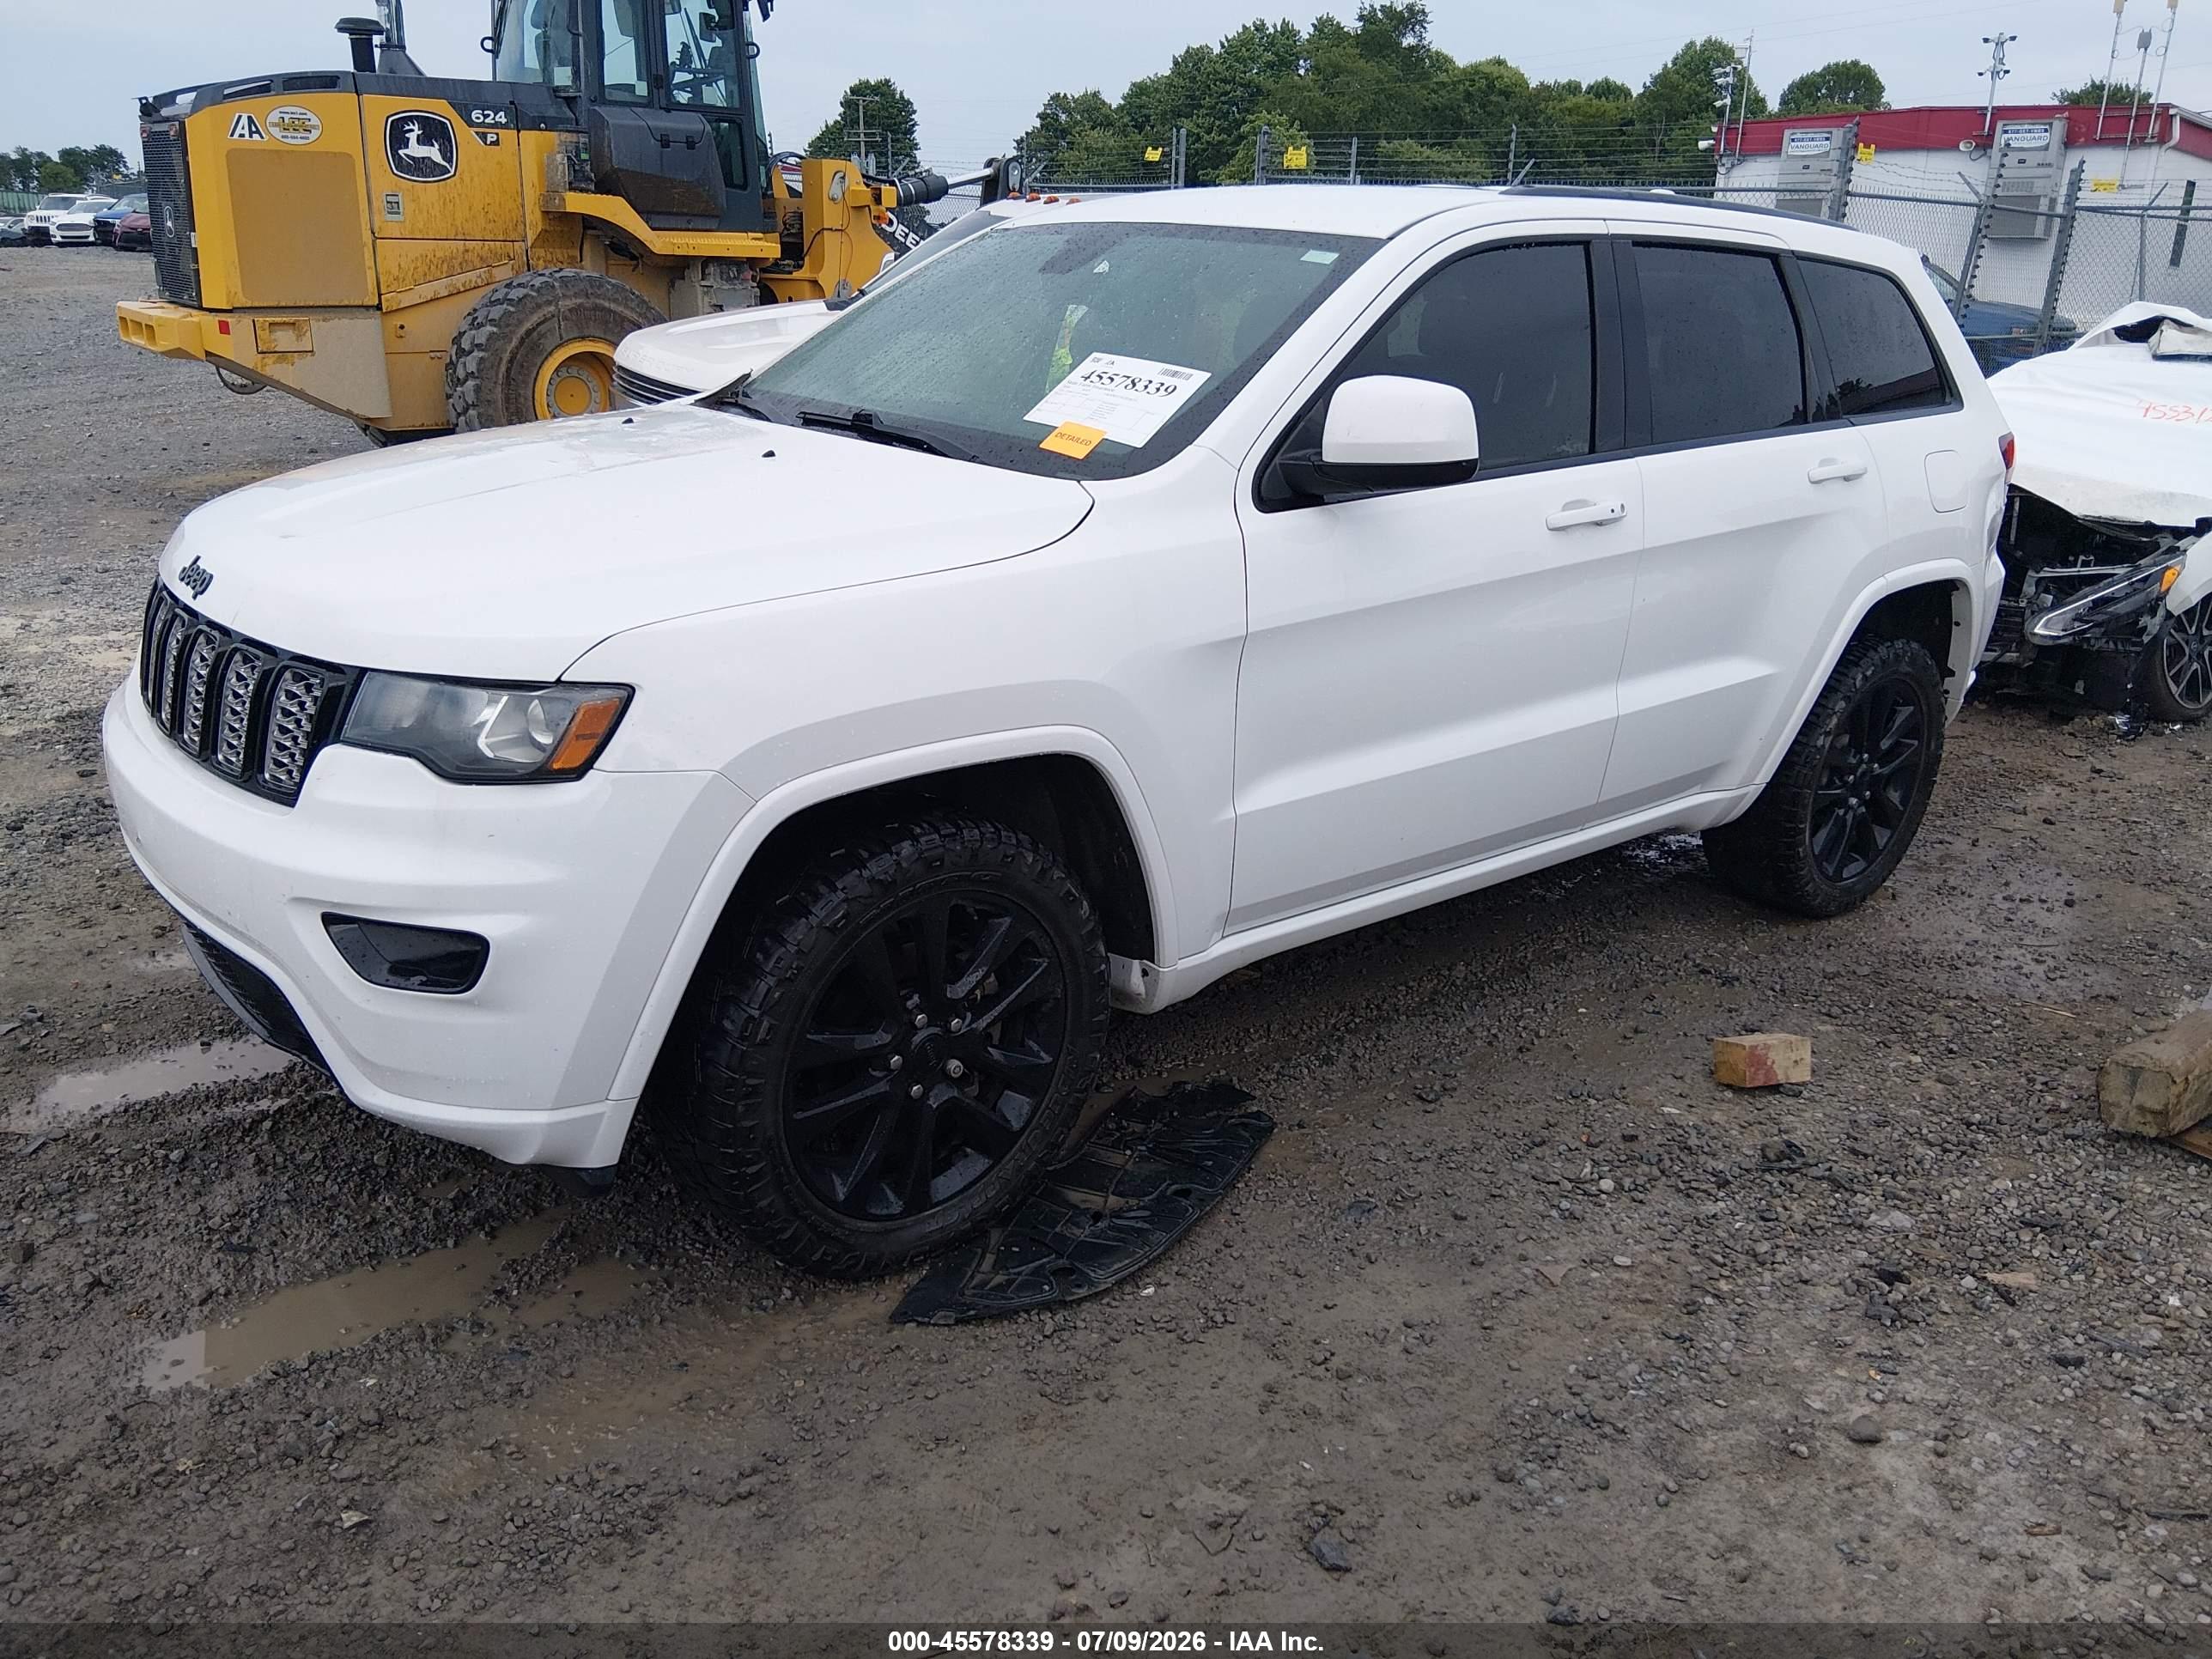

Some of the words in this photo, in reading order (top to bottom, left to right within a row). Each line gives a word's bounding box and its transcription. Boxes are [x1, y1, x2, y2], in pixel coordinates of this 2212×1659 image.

[471, 109, 508, 125] 624
[486, 133, 498, 145] P
[2003, 135, 2049, 143] VANGUARD
[1080, 369, 1177, 398] 45578339
[1054, 432, 1092, 447] DETAILED
[179, 554, 214, 601] Jeep
